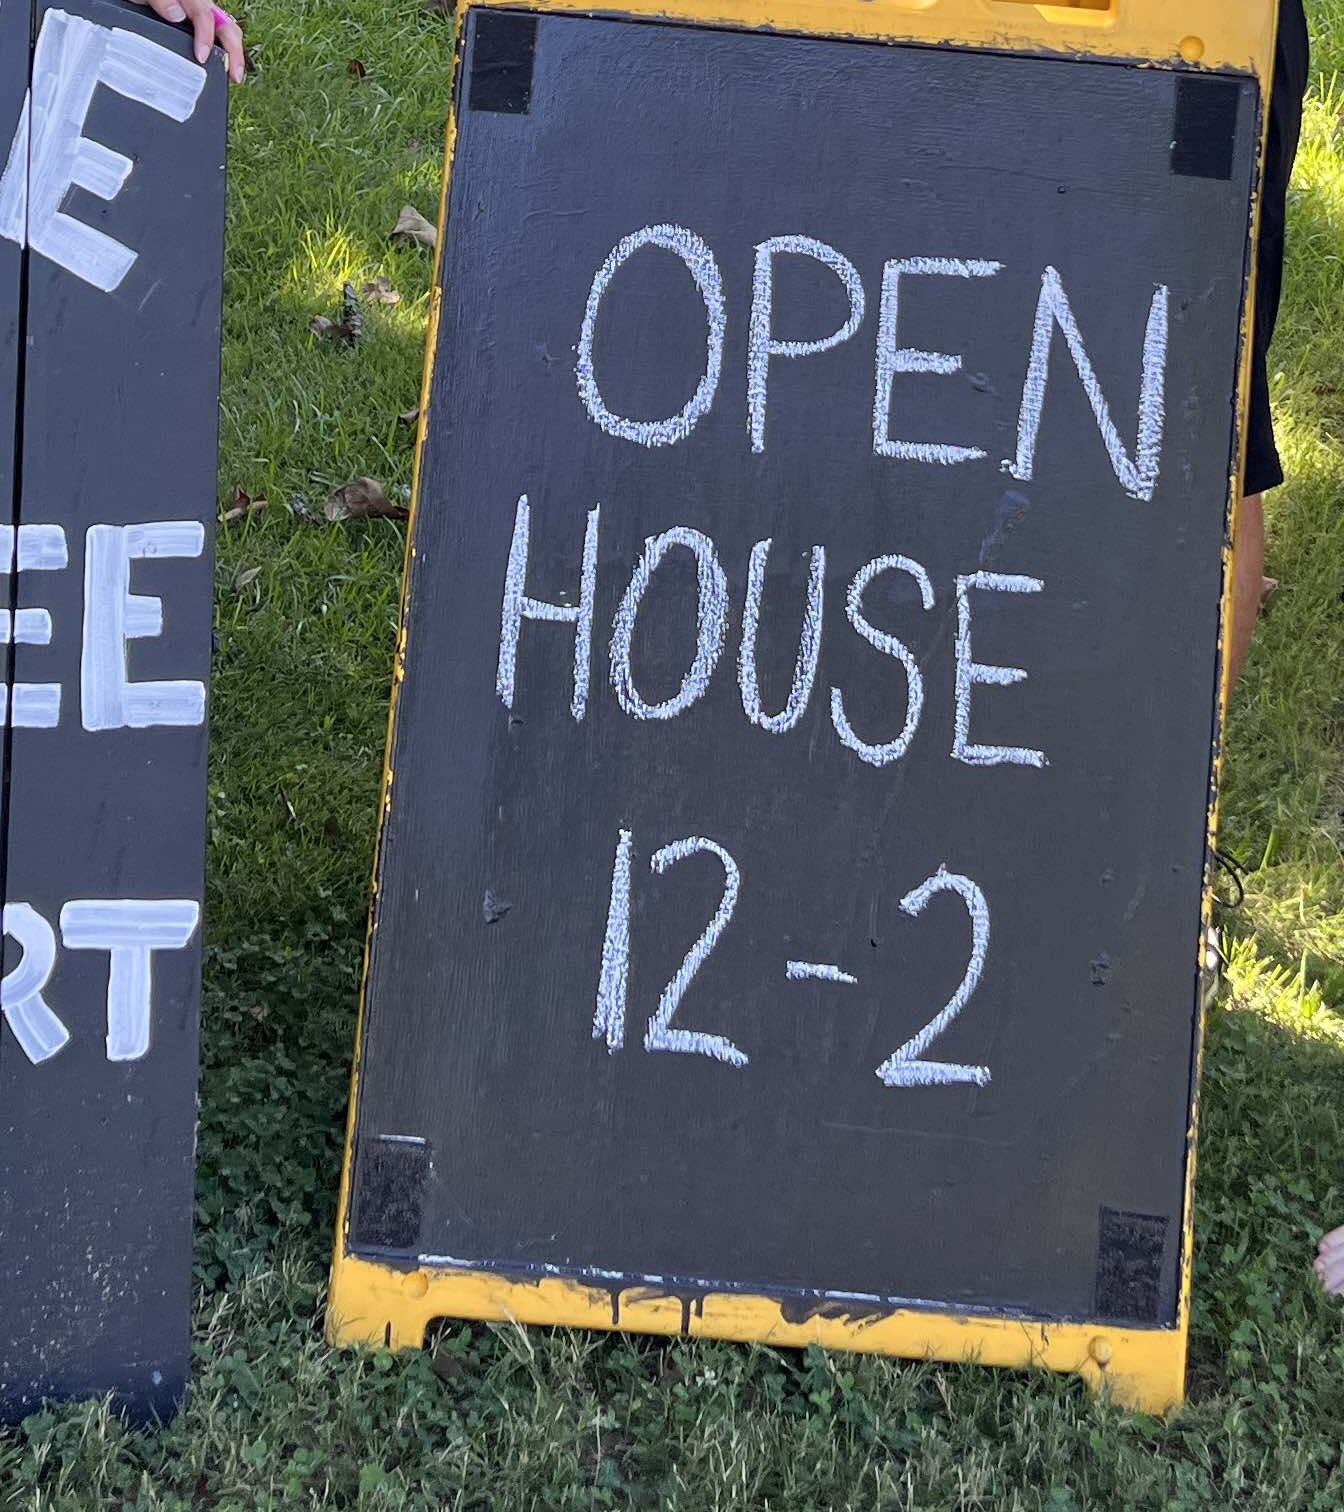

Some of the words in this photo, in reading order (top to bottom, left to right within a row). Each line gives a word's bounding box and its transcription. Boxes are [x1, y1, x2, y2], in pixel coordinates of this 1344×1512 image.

[572, 223, 1171, 502] OPEN
[495, 493, 1050, 769] HOUSE
[591, 826, 993, 1088] 12-2
